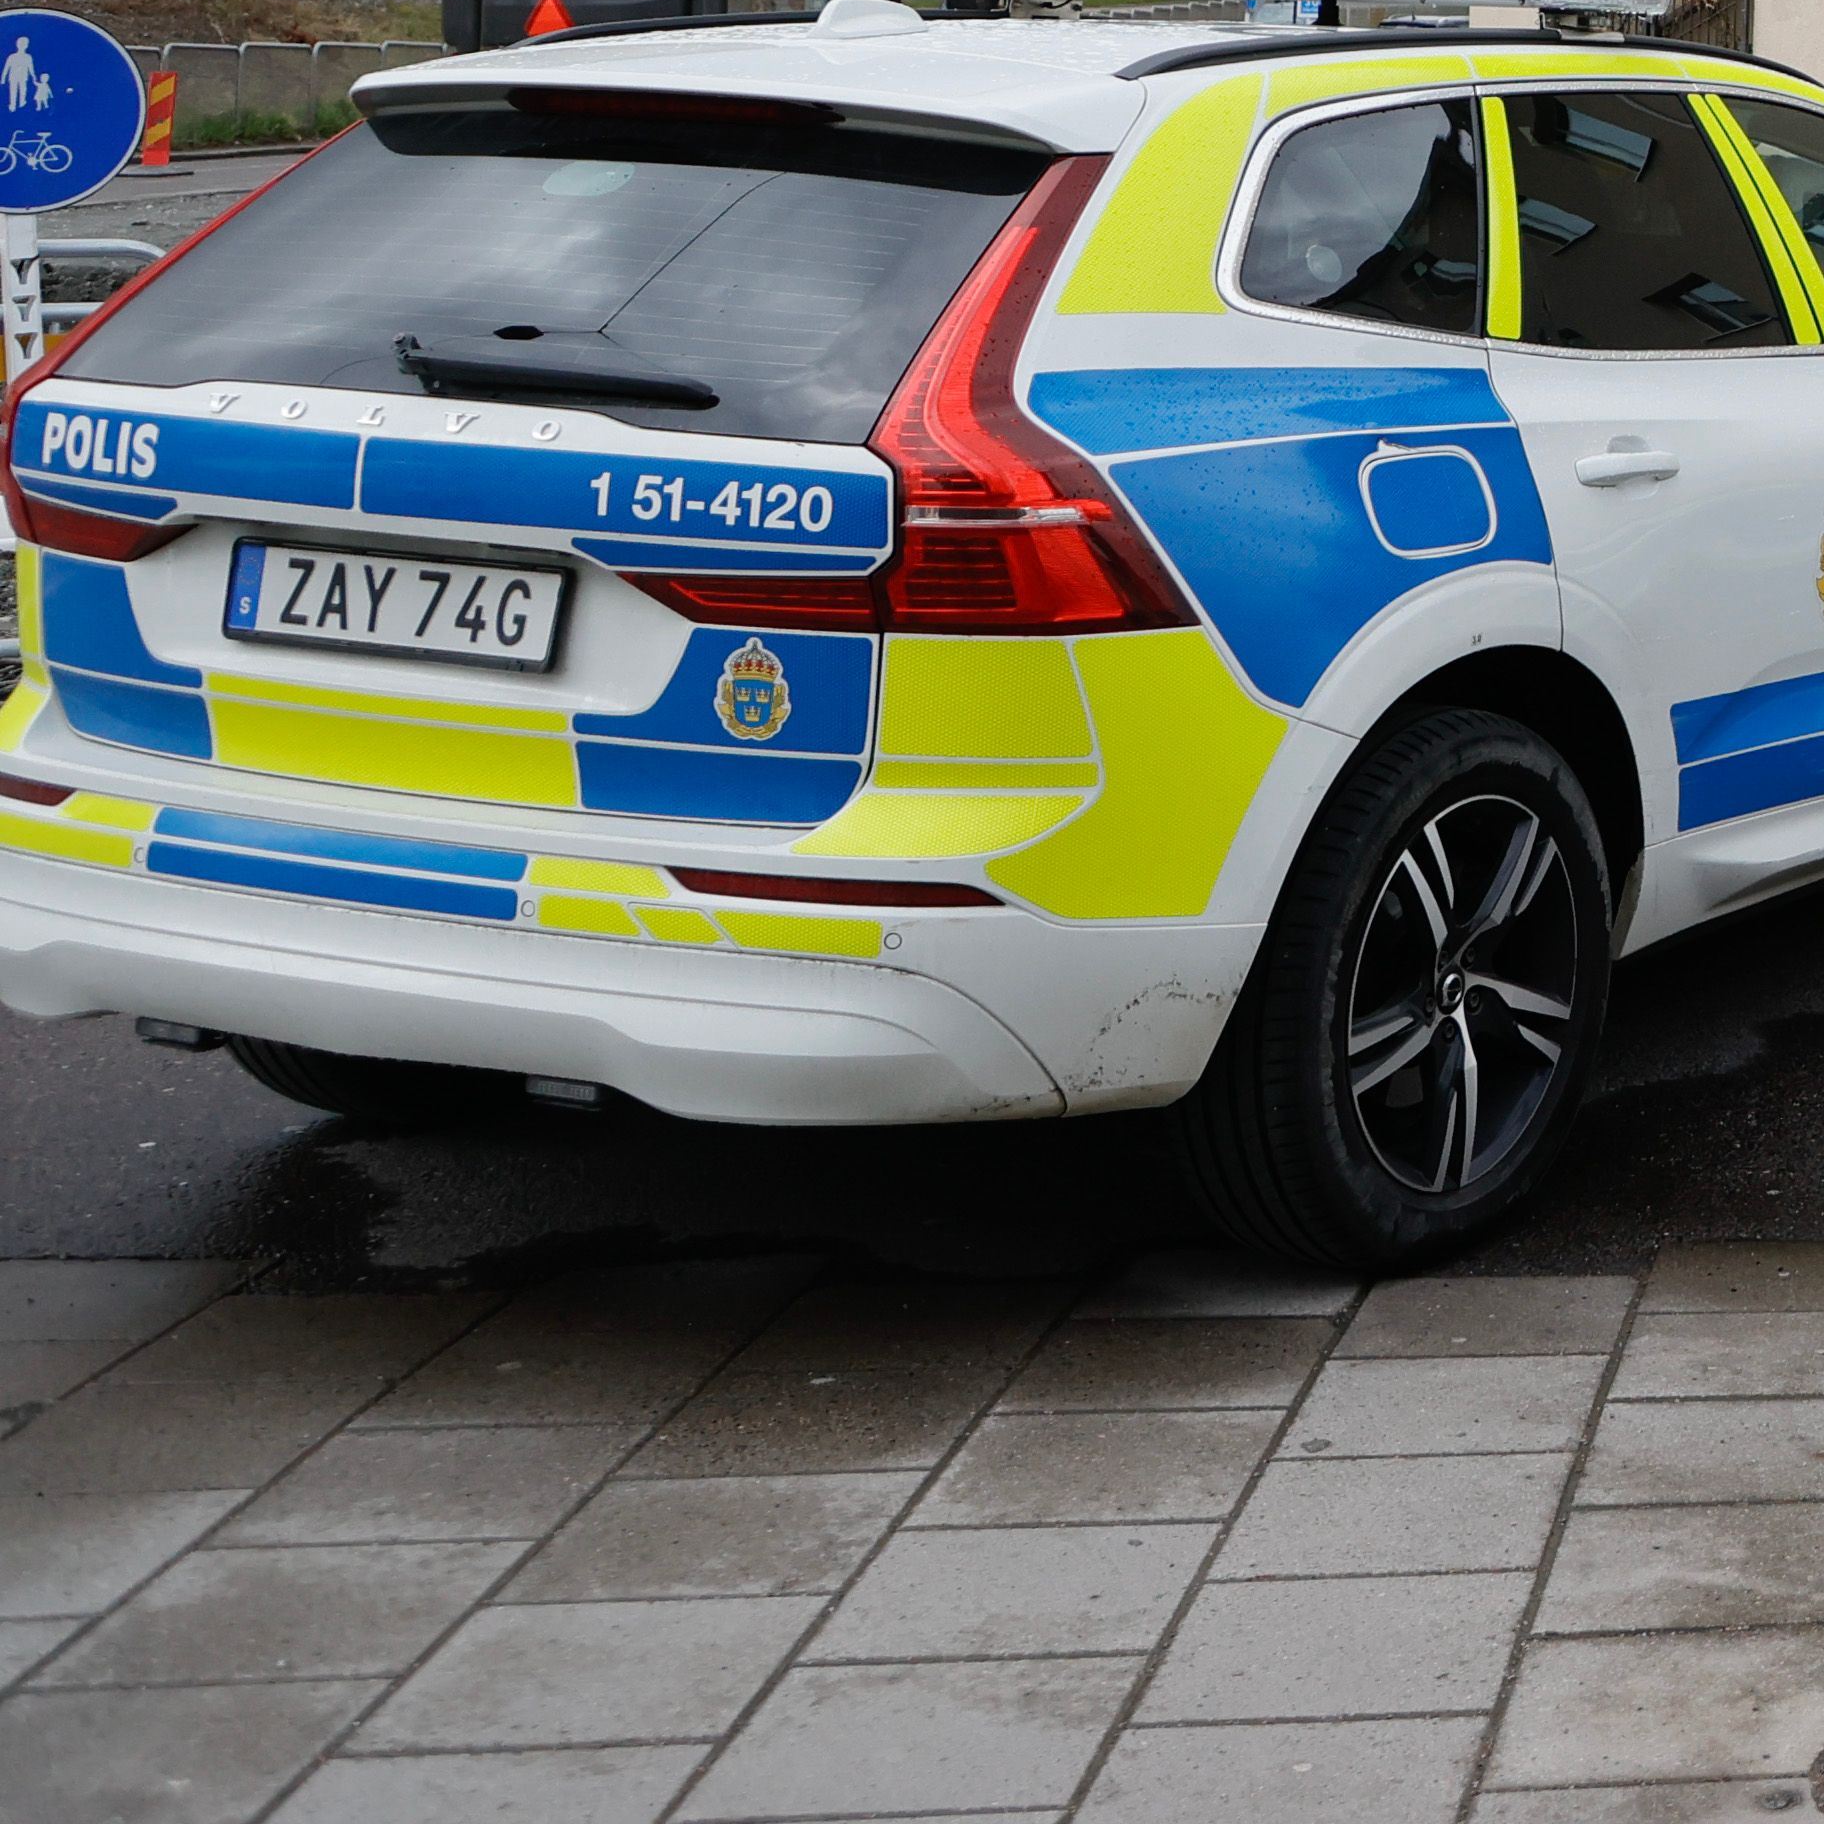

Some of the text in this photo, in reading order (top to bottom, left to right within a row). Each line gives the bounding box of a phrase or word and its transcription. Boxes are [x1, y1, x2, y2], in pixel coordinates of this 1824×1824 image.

[42, 412, 161, 478] POLIS
[207, 392, 563, 442] VOLVO
[590, 471, 834, 532] 1 51-4120
[239, 596, 251, 615] S
[280, 557, 532, 647] ZAY 74G
